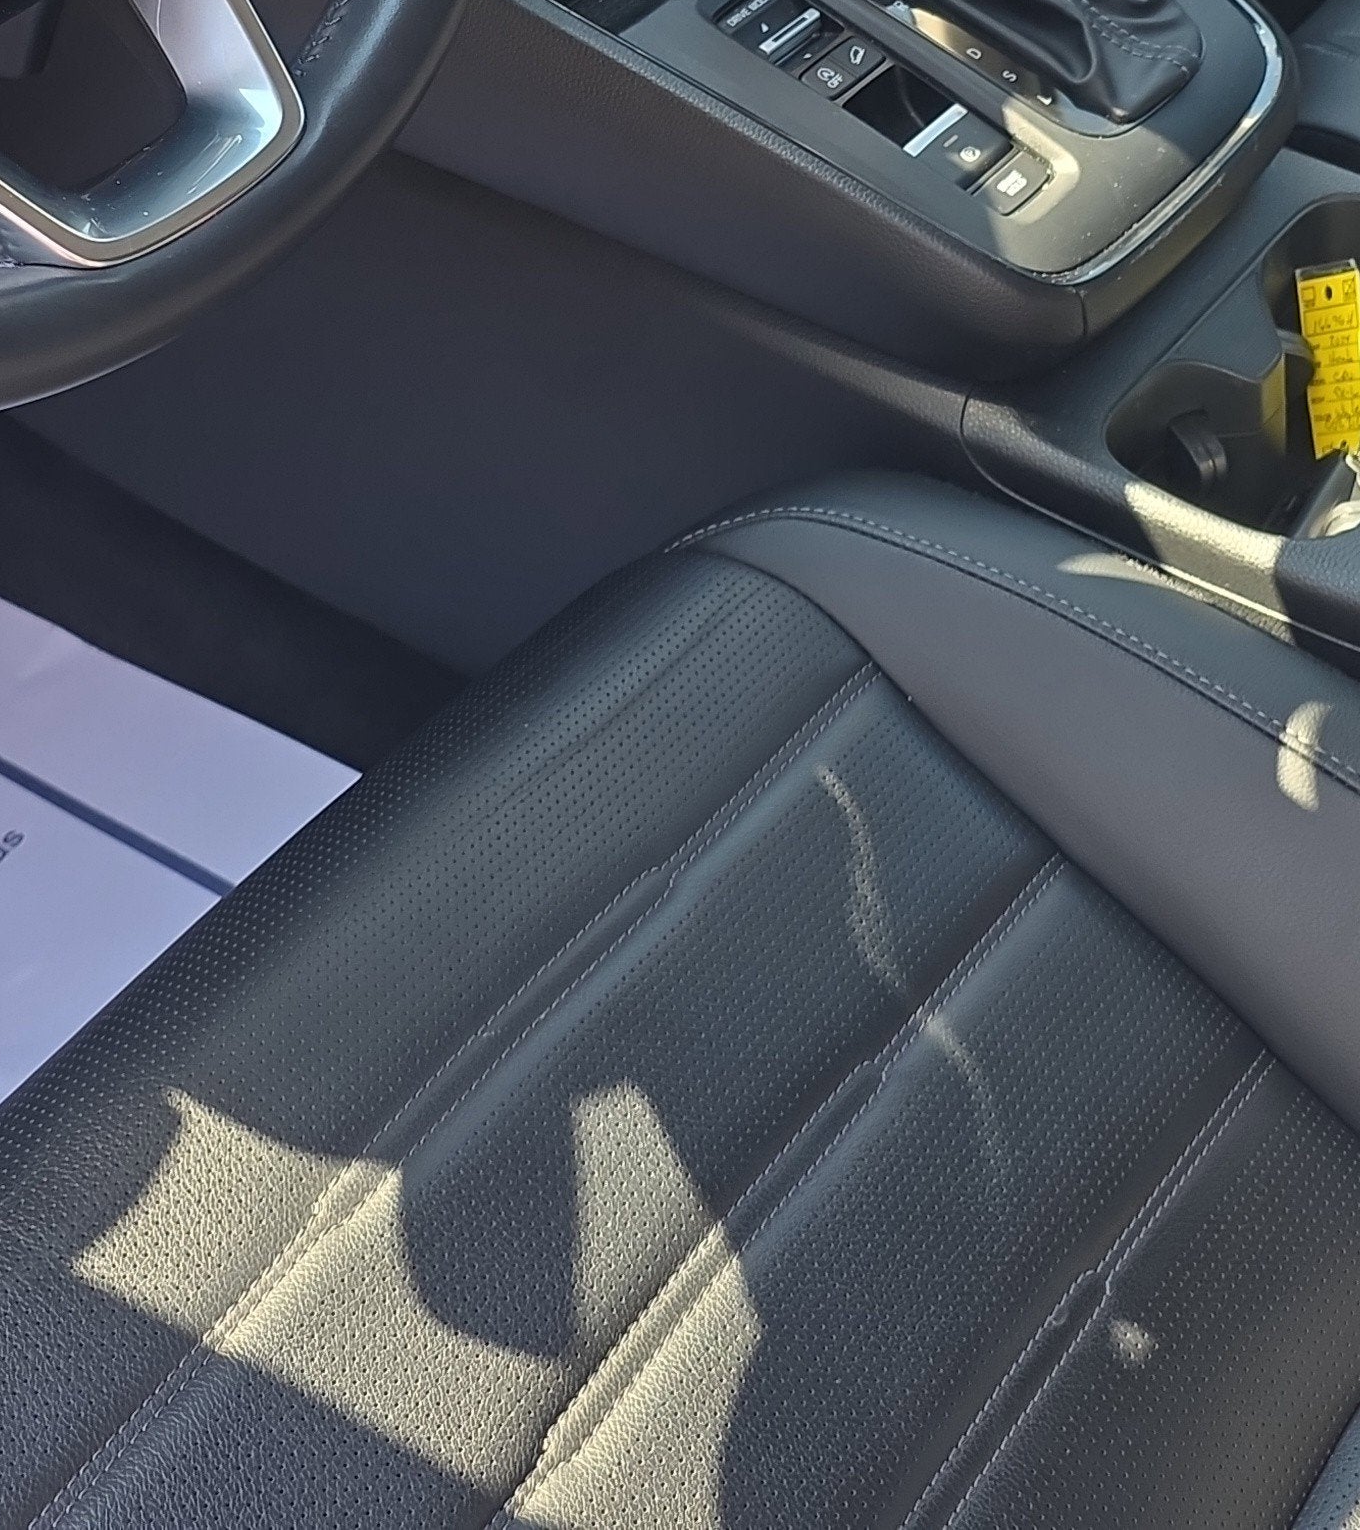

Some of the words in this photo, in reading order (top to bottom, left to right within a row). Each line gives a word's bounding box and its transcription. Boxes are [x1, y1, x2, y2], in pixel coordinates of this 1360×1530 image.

[726, 7, 752, 28] DRIVE
[966, 47, 983, 61] D
[1002, 69, 1018, 84] S
[1036, 93, 1053, 107] L
